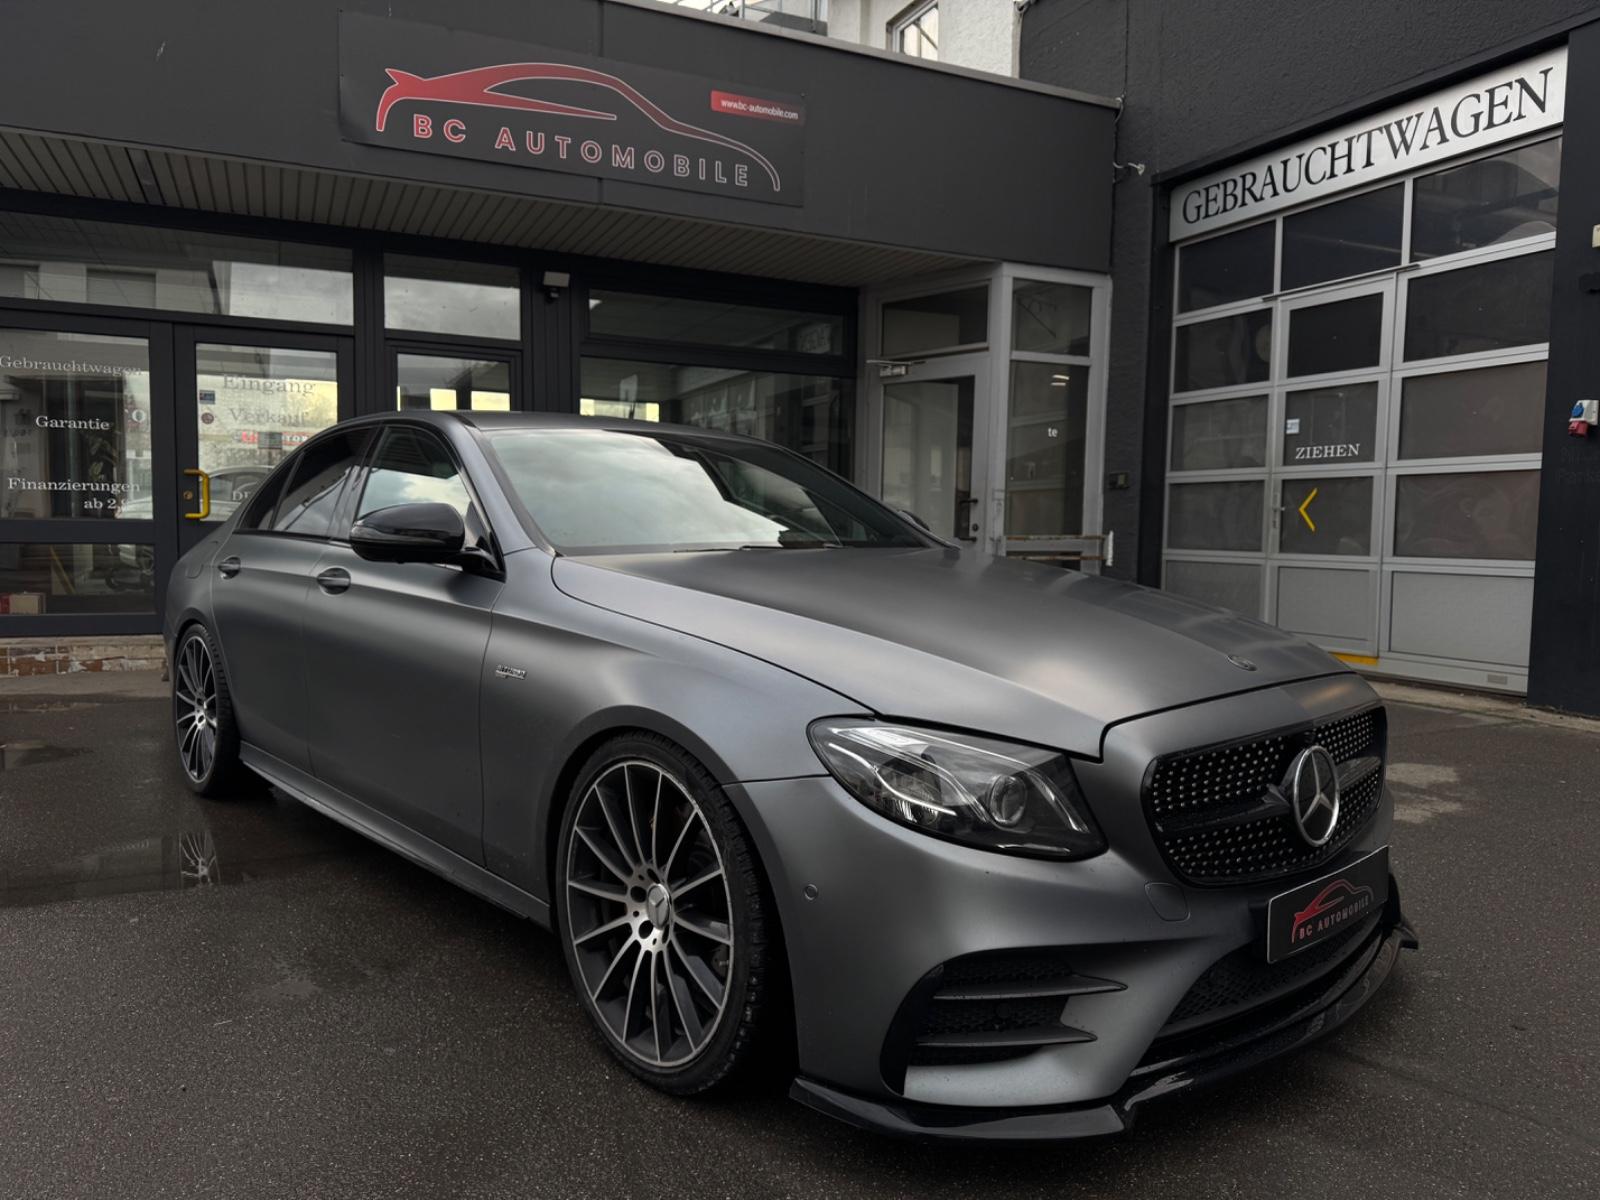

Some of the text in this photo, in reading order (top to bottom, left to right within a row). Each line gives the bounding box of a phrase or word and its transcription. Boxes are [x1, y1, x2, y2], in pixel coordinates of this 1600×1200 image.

[720, 99, 800, 120] www.bc-automobile.com
[412, 113, 750, 188] BC AUTOMOBILE
[1182, 67, 1553, 224] GEBRAUCHTWAGEN
[222, 374, 316, 397] Eingang
[35, 415, 111, 431] Garantie
[1295, 442, 1361, 460] ZIEHEN
[7, 477, 141, 493] Finanzierungen
[83, 498, 104, 510] ab
[1299, 895, 1369, 940] BC AUTOMOBILE
